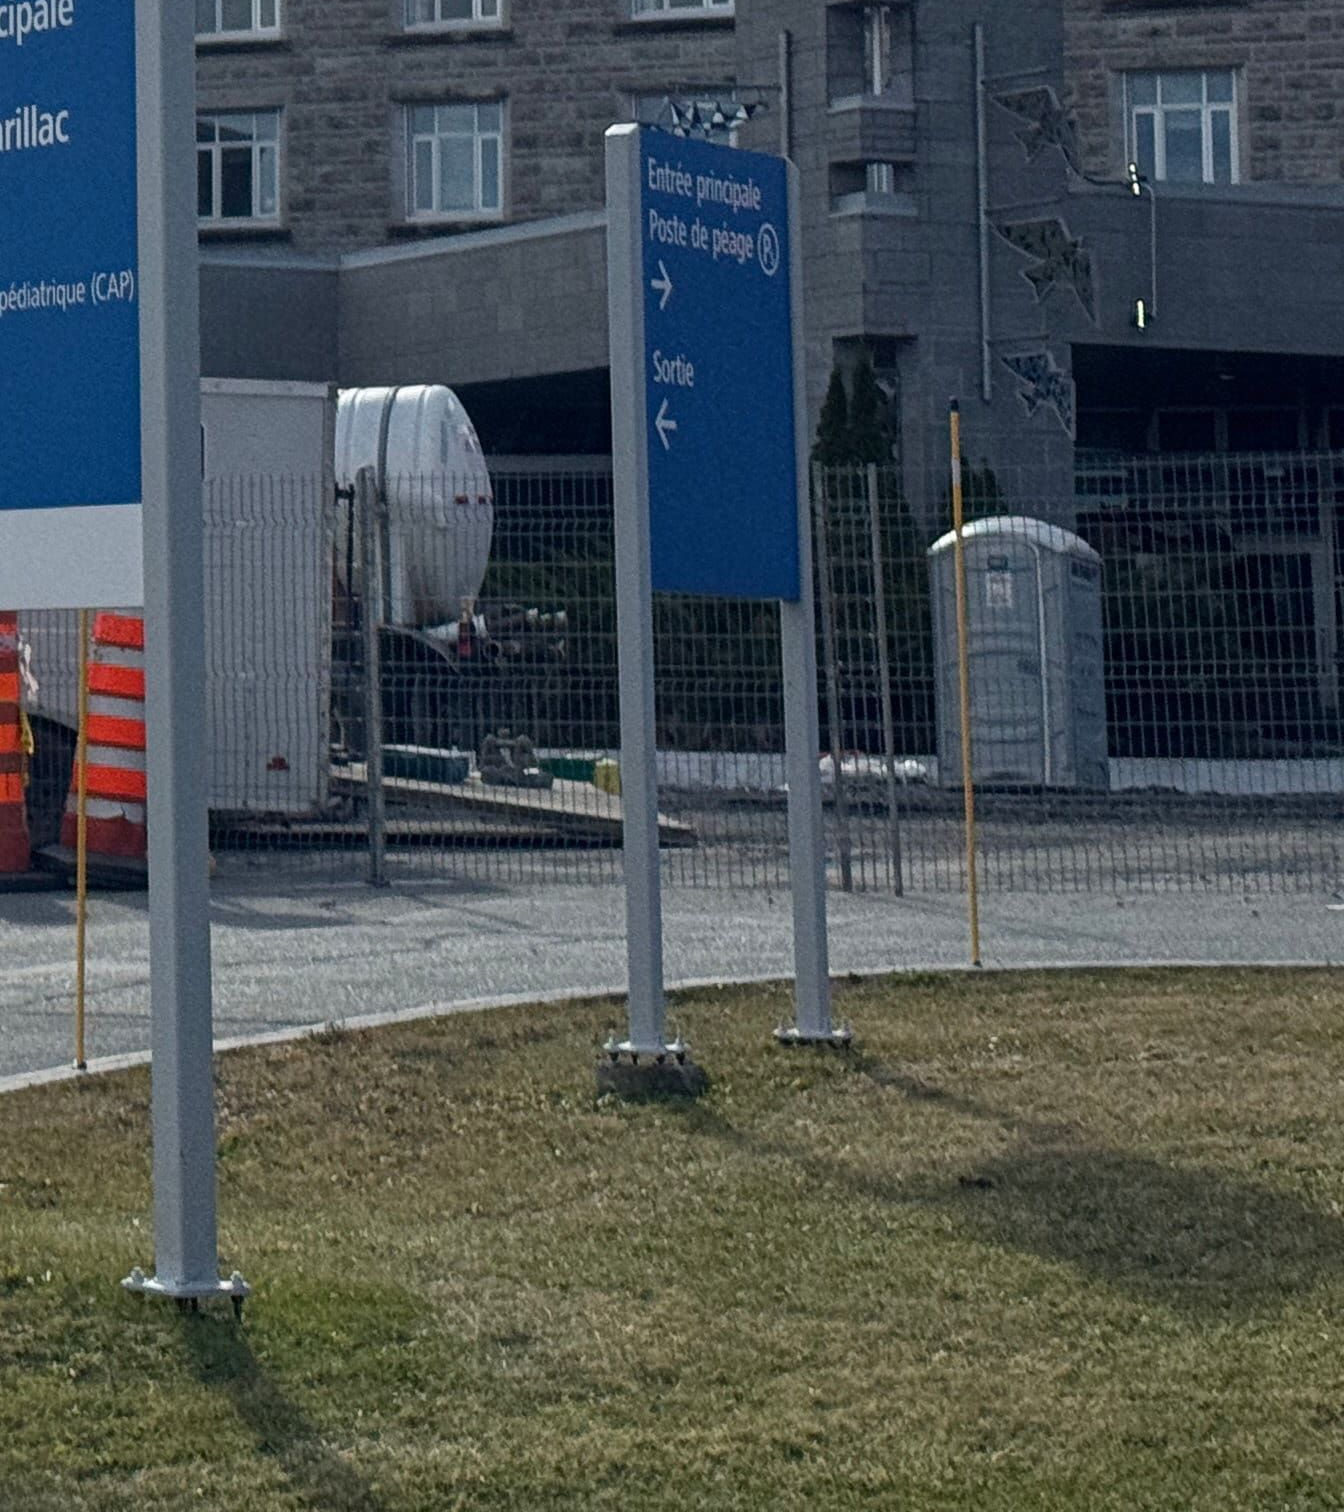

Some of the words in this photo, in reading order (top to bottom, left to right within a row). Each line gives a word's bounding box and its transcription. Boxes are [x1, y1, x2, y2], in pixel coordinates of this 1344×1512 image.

[648, 157, 692, 197] Entrée
[697, 170, 761, 213] principale
[649, 209, 687, 247] Poste
[691, 217, 708, 250] de
[713, 222, 754, 264] péage
[0, 280, 85, 317] pédiatrique
[91, 269, 134, 304] (CAP)
[653, 350, 694, 387] Sortie
